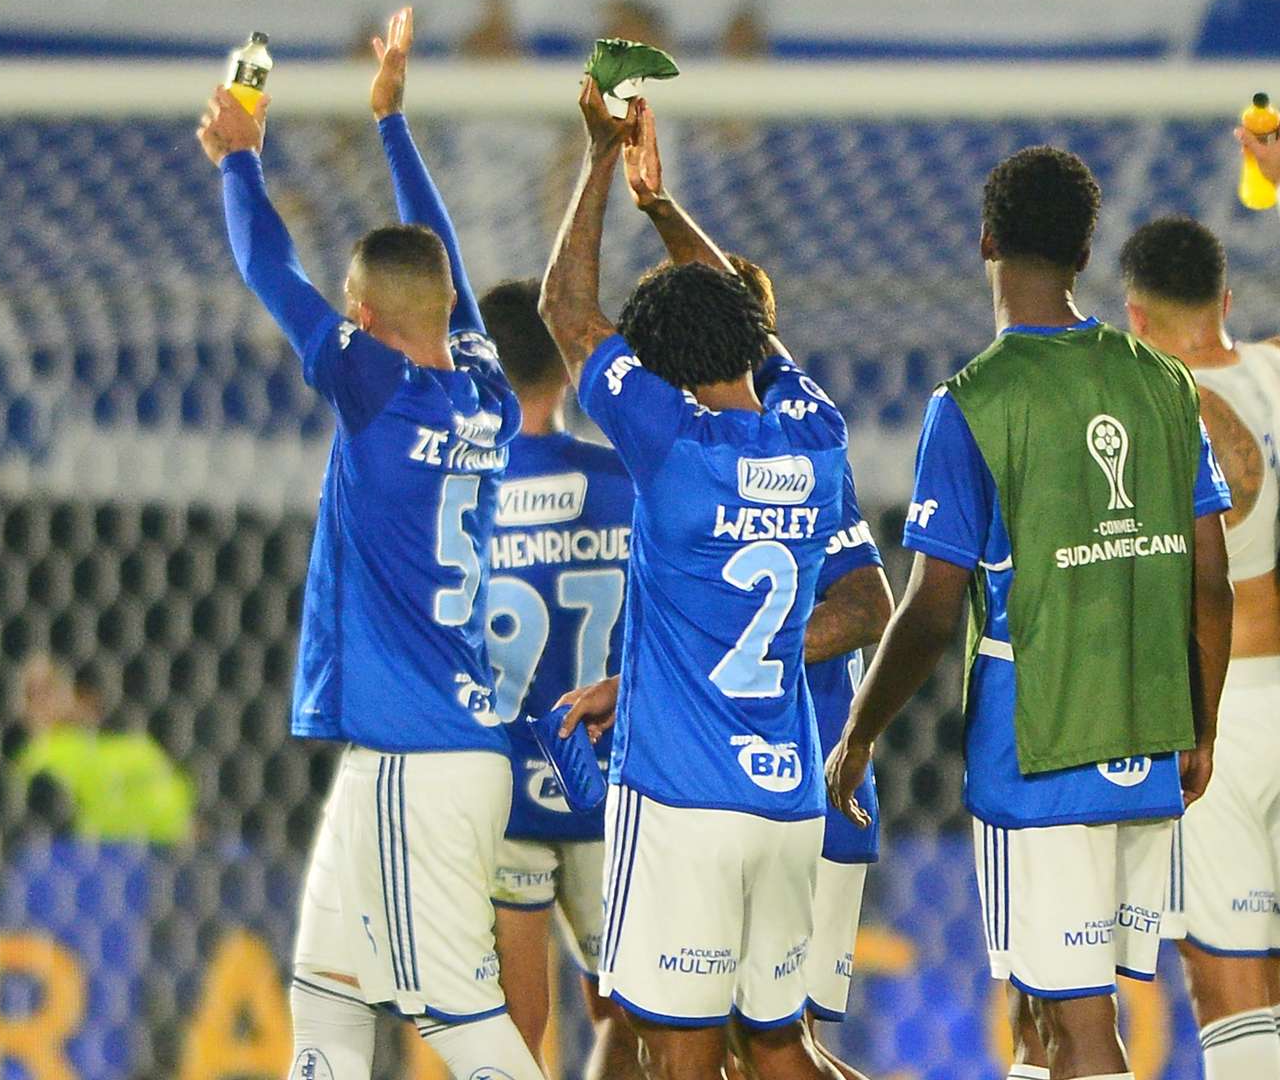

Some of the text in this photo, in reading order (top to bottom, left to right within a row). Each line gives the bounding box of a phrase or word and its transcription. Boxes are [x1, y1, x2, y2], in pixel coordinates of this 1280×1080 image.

[745, 461, 809, 493] Vilma
[713, 504, 819, 541] WESLEY
[434, 474, 482, 627] 5
[490, 528, 632, 570] HENRIQUE
[708, 540, 799, 699] 2
[486, 569, 626, 723] 97
[751, 753, 796, 778] BH
[1119, 903, 1160, 919] FACULD
